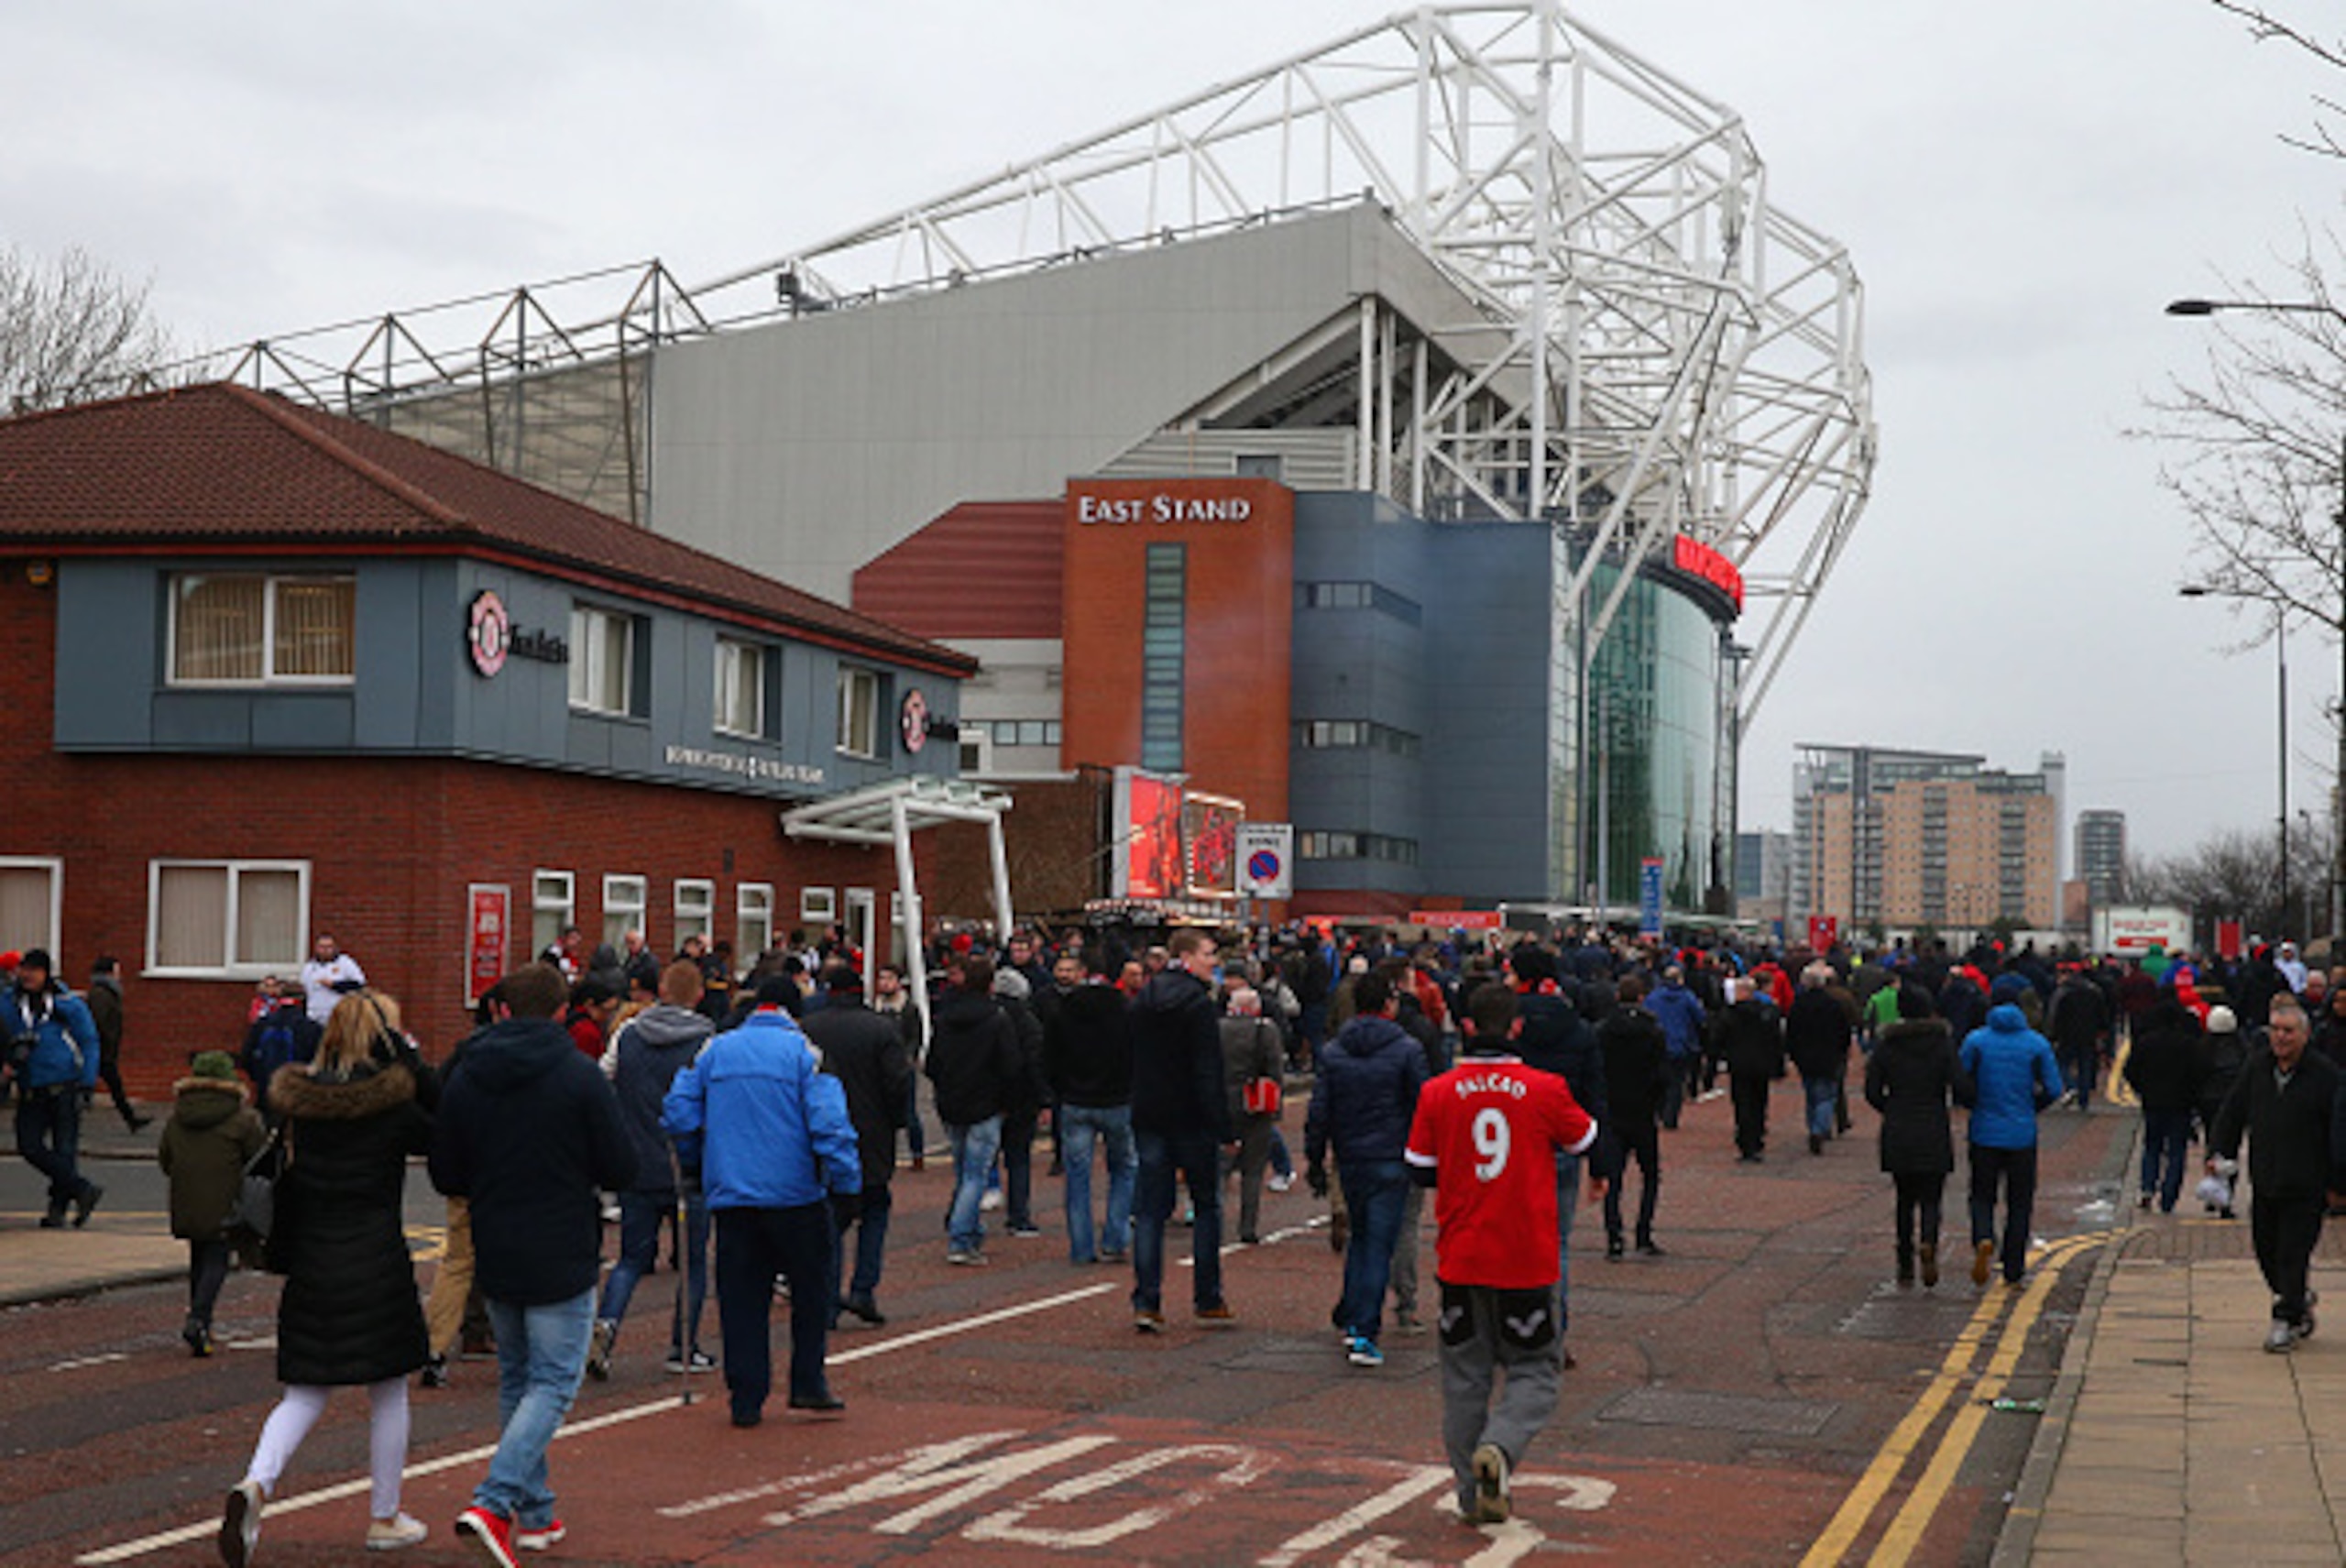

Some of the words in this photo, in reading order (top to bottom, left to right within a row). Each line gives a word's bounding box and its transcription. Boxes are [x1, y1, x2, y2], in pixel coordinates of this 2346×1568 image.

[1080, 495, 1146, 524] EAST
[1151, 493, 1251, 523] STAND
[1472, 1107, 1511, 1182] 9
